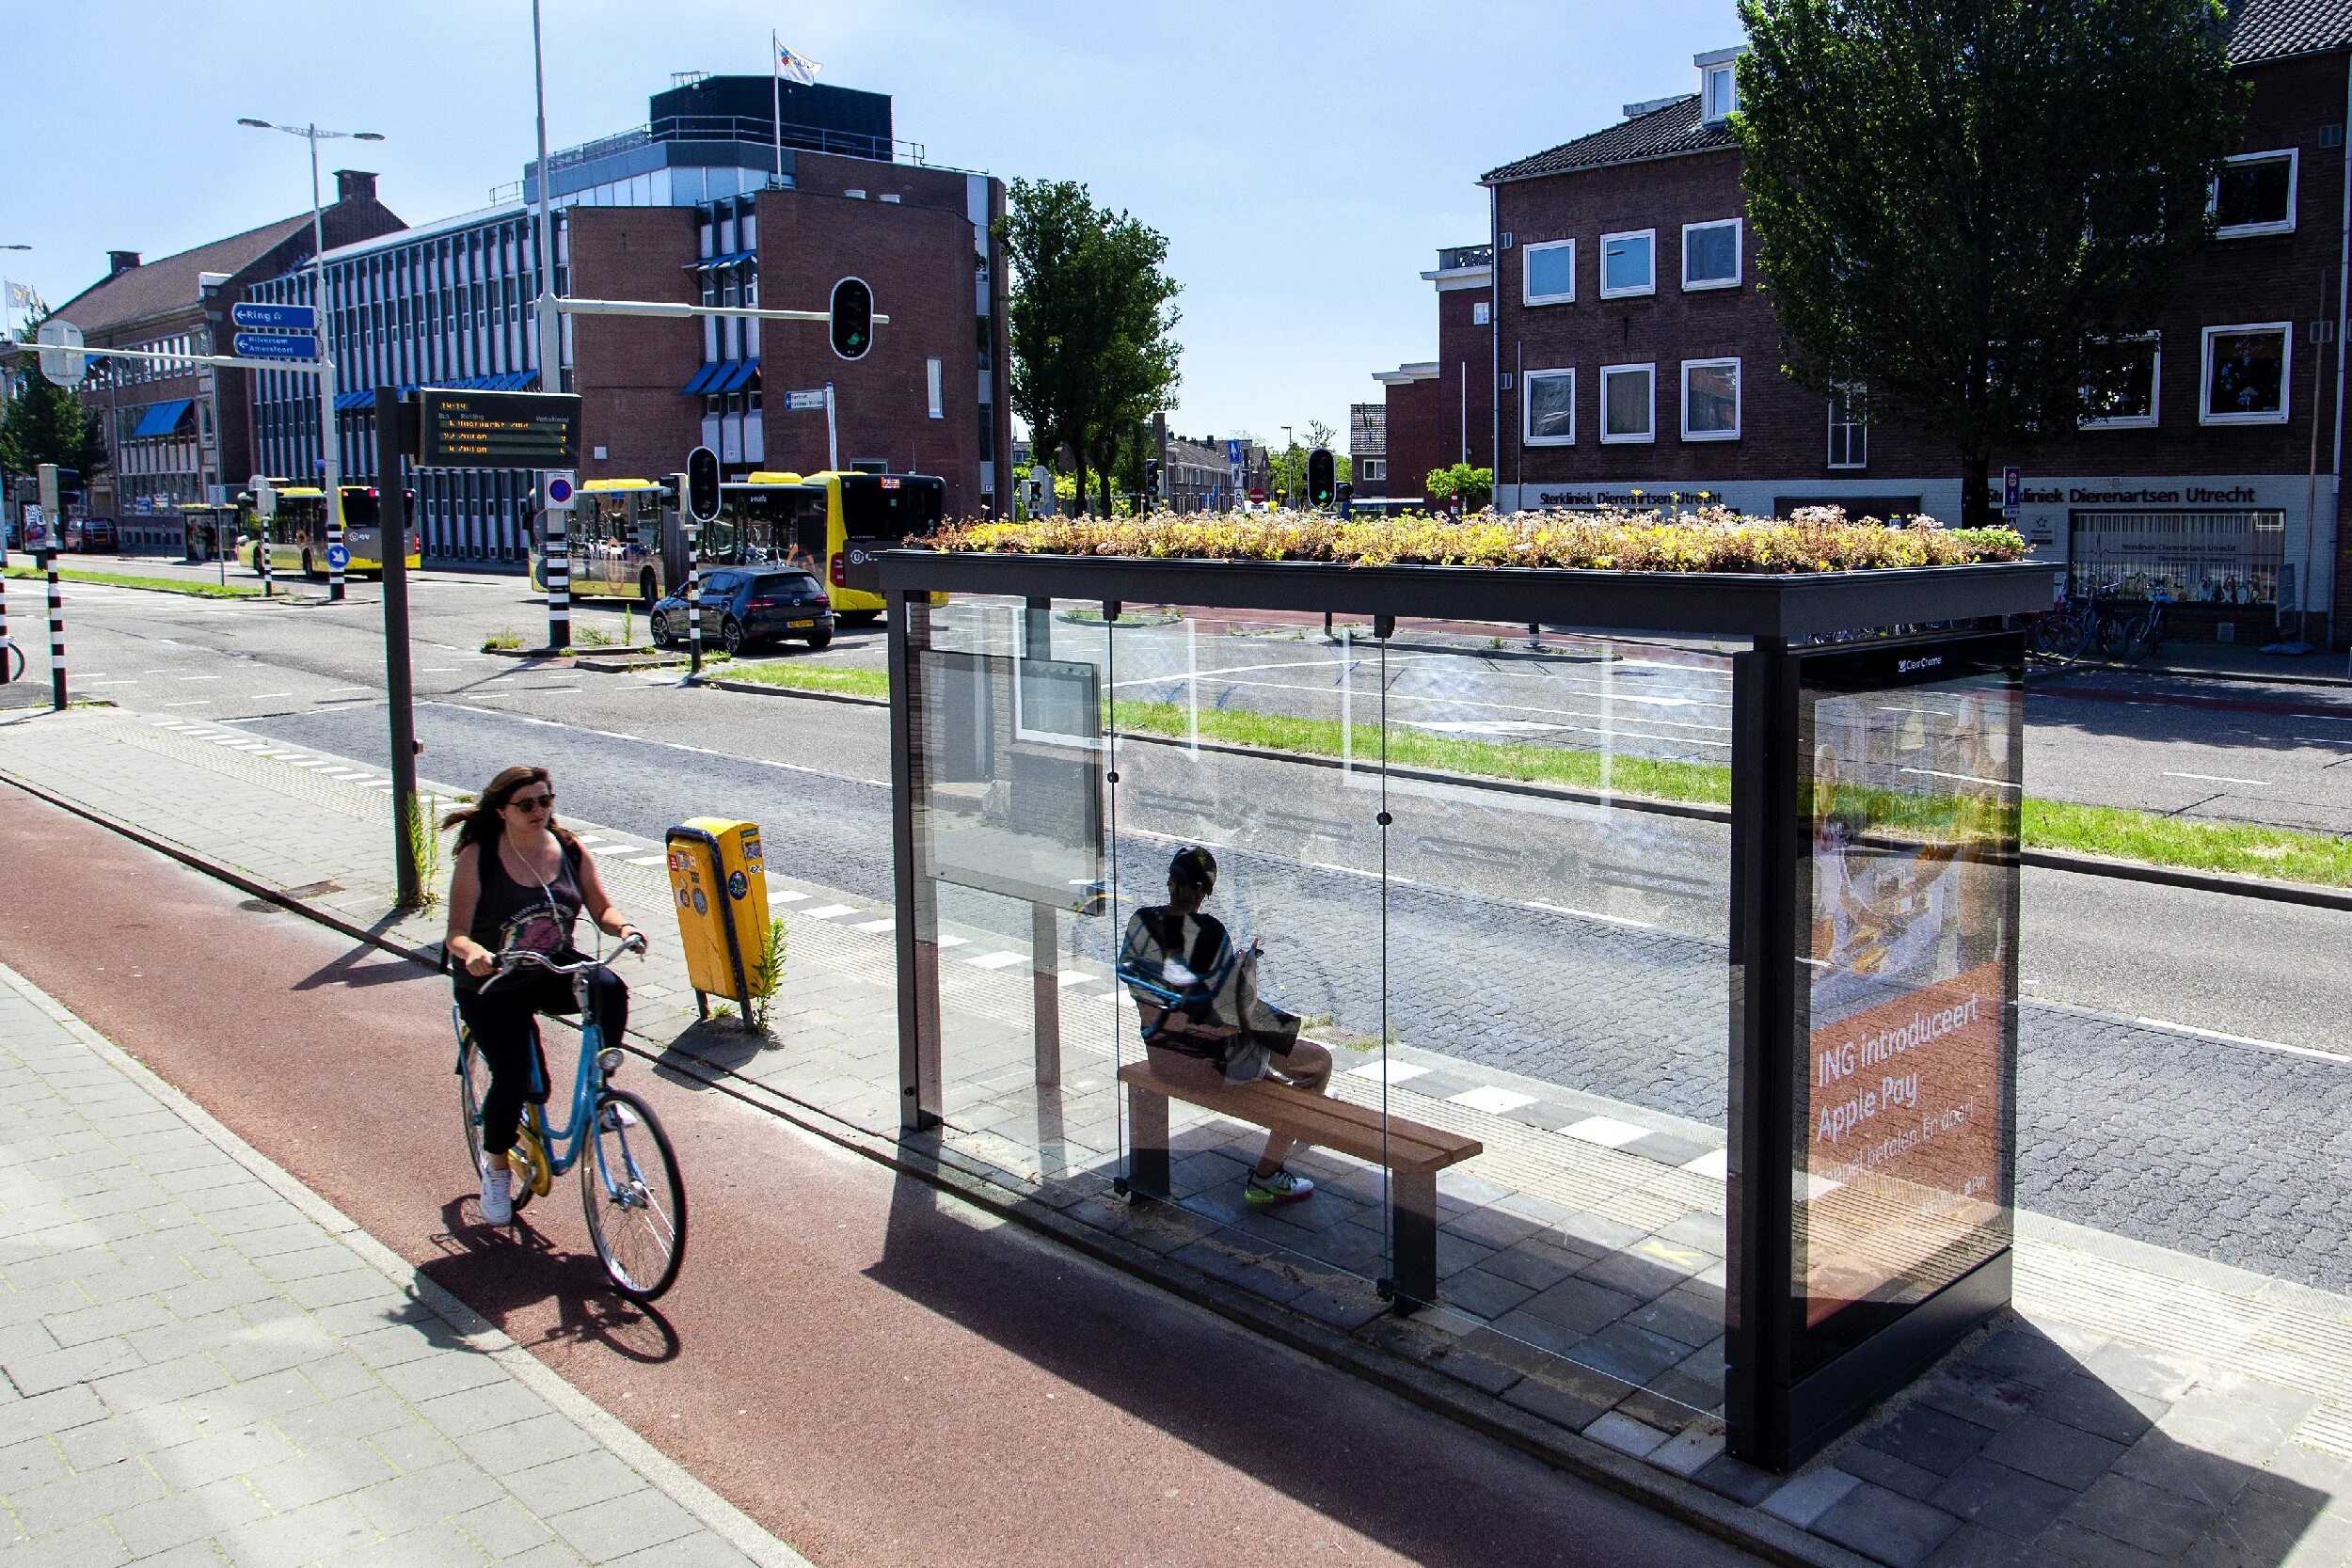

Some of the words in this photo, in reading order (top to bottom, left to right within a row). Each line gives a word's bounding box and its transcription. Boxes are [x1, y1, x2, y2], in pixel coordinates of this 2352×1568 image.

[246, 310, 271, 323] Ring
[1539, 492, 1594, 505] Sterkliniek
[1597, 491, 1671, 505] Dierenartsen
[1988, 486, 2064, 503] Steliniek
[2070, 487, 2179, 503] Dierenartsen
[2185, 486, 2256, 503] Utrecht
[2158, 544, 2205, 552] Dierenartsen
[1819, 1041, 1855, 1087] ING
[1861, 993, 1979, 1068] introduceert
[1817, 1087, 1876, 1144] Apple
[1882, 1070, 1918, 1110] Pay
[1867, 1130, 1921, 1166] betalen.
